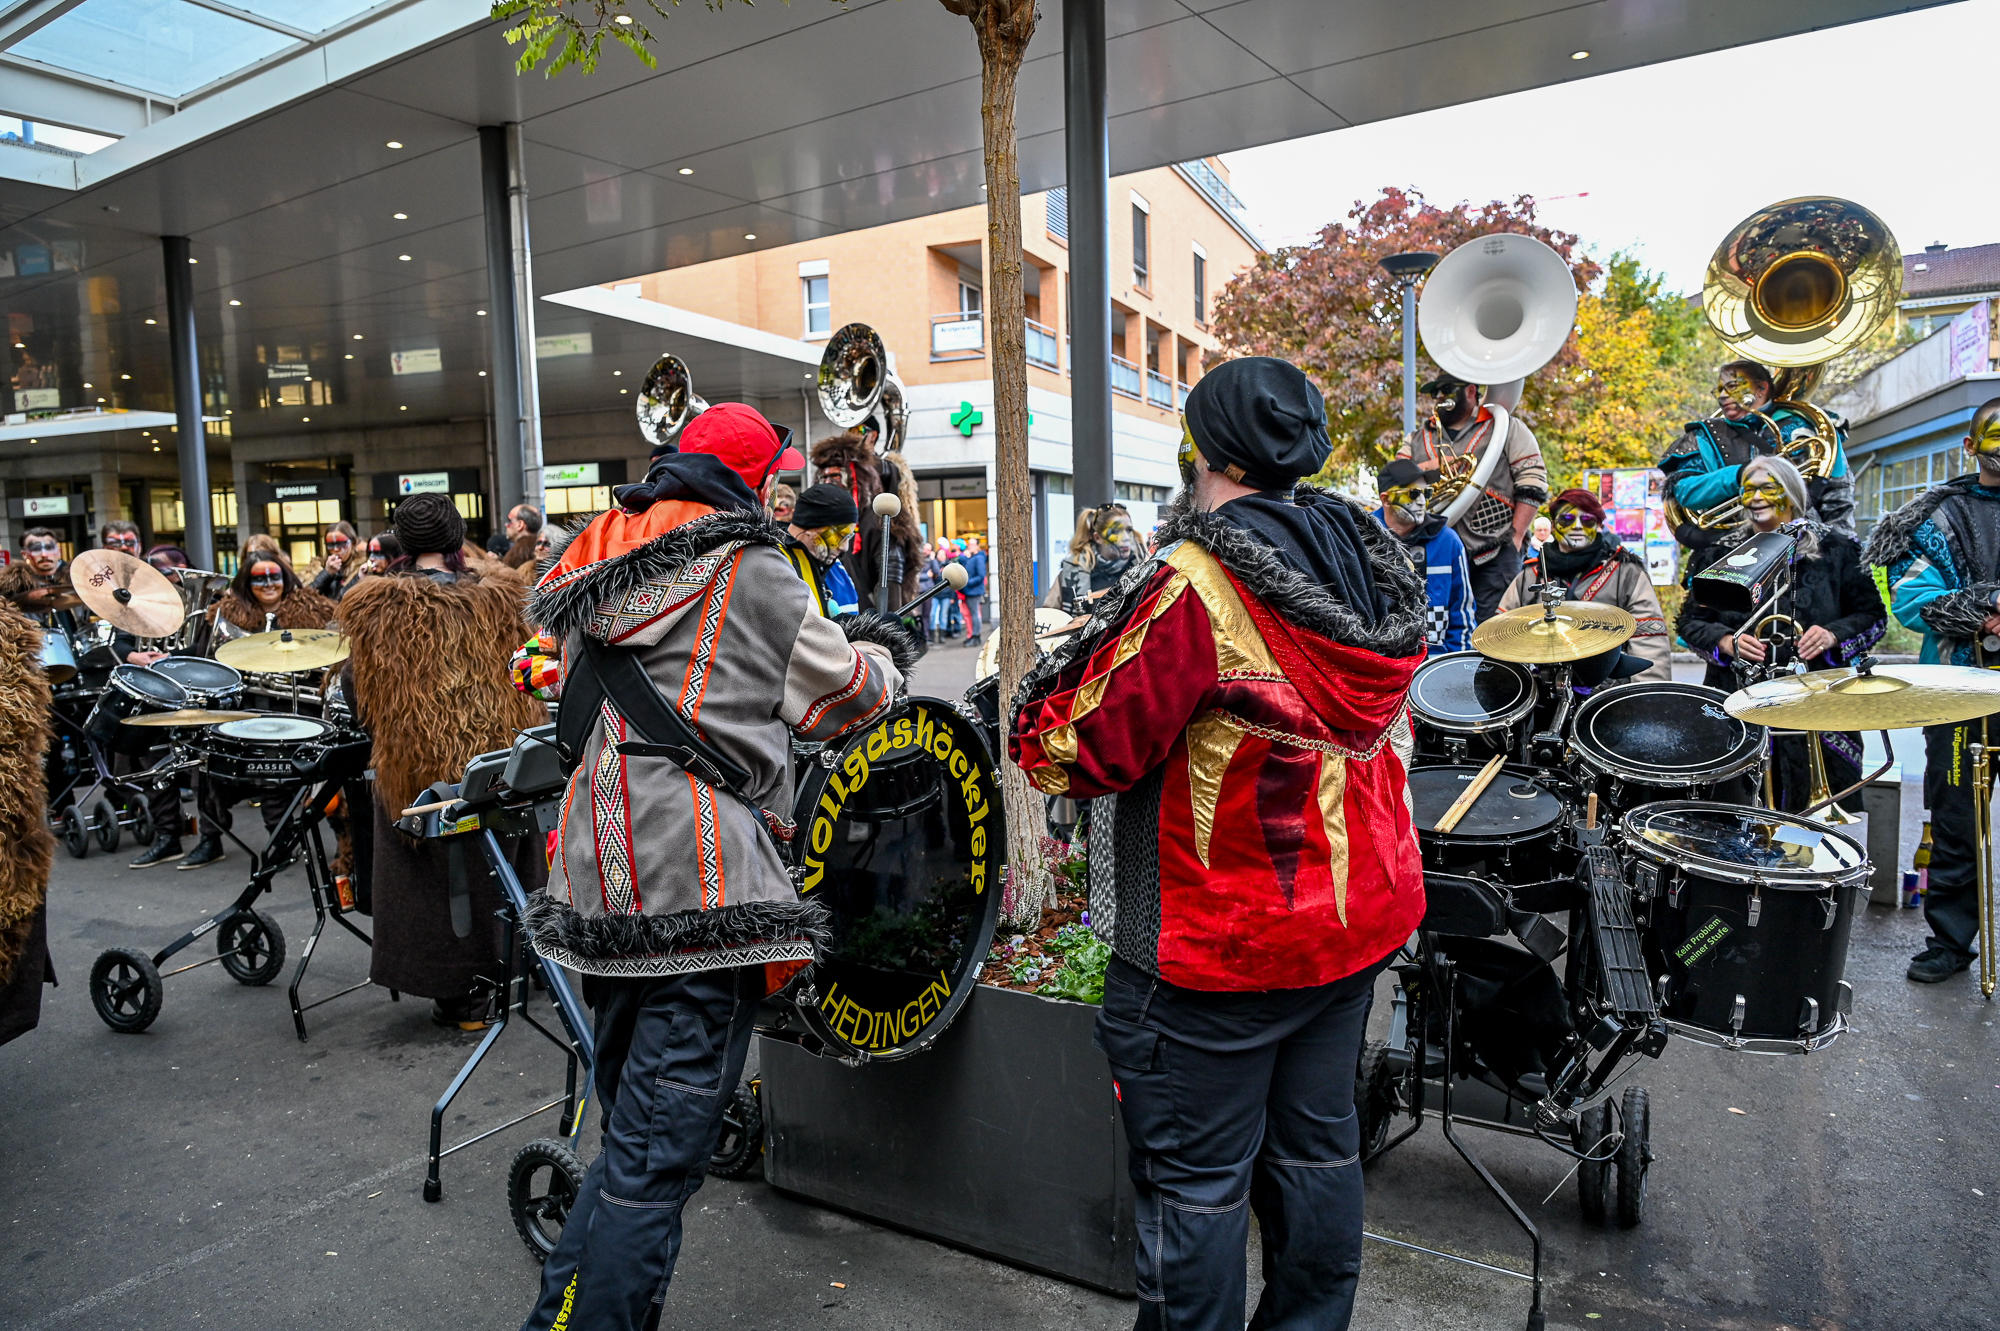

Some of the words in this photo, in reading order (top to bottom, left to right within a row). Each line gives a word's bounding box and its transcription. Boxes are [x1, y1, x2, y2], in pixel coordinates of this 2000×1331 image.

[276, 486, 299, 497] MIGROS
[300, 485, 318, 495] BANK
[413, 477, 446, 487] swisscom
[1675, 942, 1693, 959] Kein
[1690, 918, 1722, 945] Problem
[1684, 943, 1709, 967] meiner
[1706, 926, 1729, 946] Stufe
[821, 969, 952, 1048] HEDINGEN
